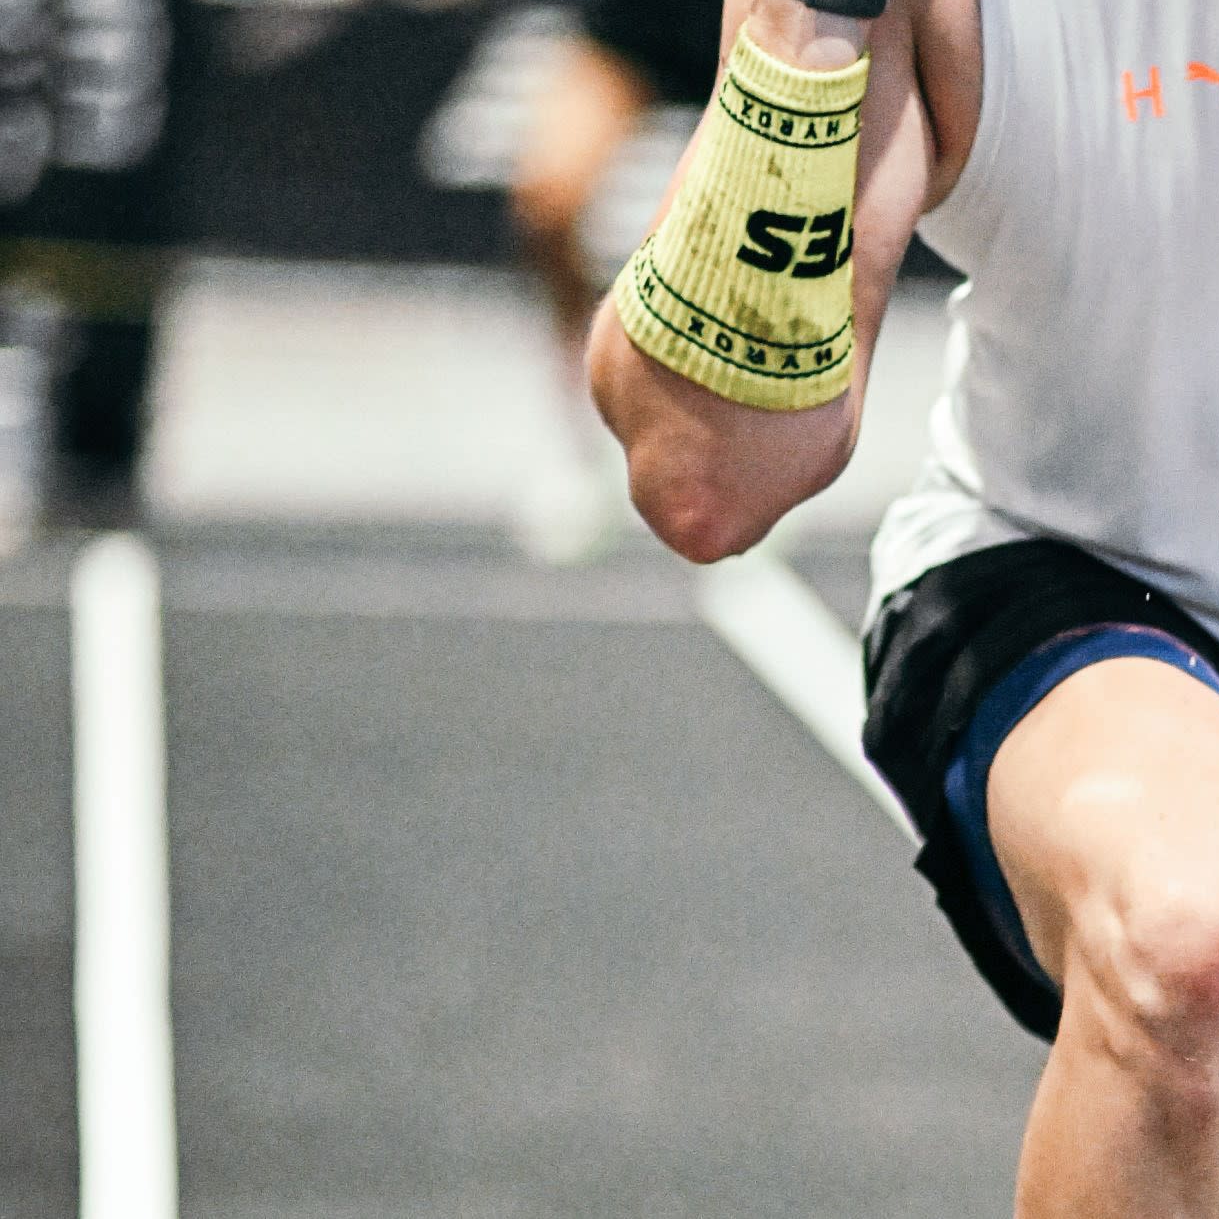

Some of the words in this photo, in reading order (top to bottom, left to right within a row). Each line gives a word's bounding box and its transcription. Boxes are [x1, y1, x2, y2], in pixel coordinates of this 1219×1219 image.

[741, 99, 840, 139] HYROX
[737, 207, 854, 279] ES
[688, 316, 833, 370] HYROX
